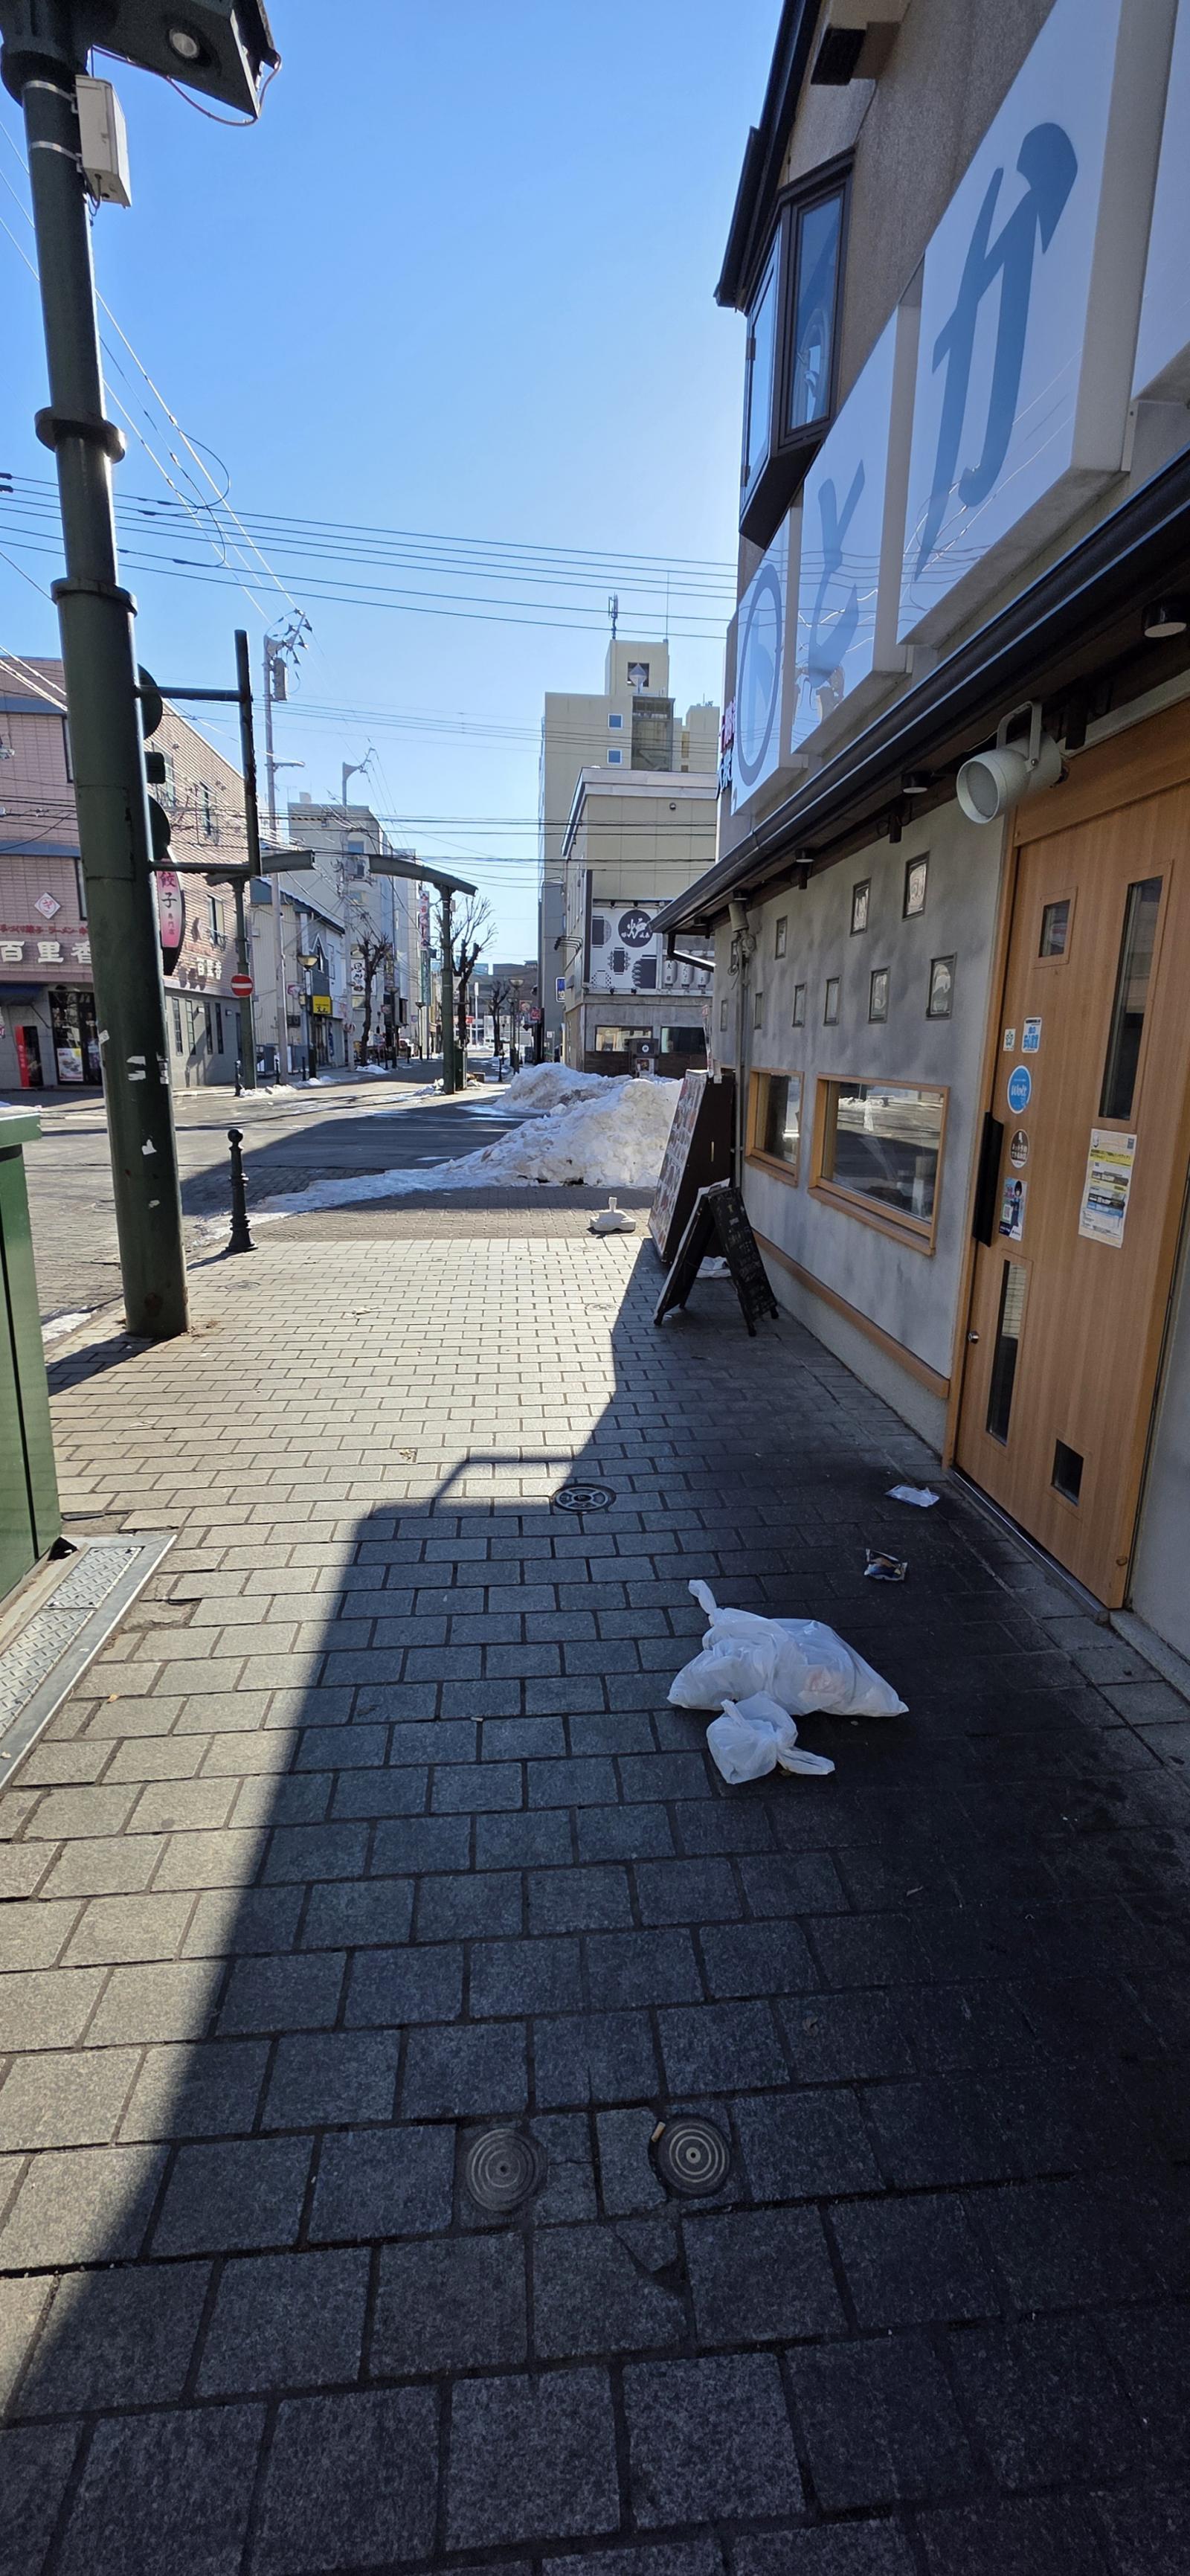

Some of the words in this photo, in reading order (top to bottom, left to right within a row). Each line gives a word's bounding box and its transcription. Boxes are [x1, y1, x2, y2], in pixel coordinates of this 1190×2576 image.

[157, 872, 177, 908] 餃子
[0, 940, 91, 964] 百里香
[196, 957, 222, 980] 百里香
[1011, 1084, 1026, 1096] Wolt
